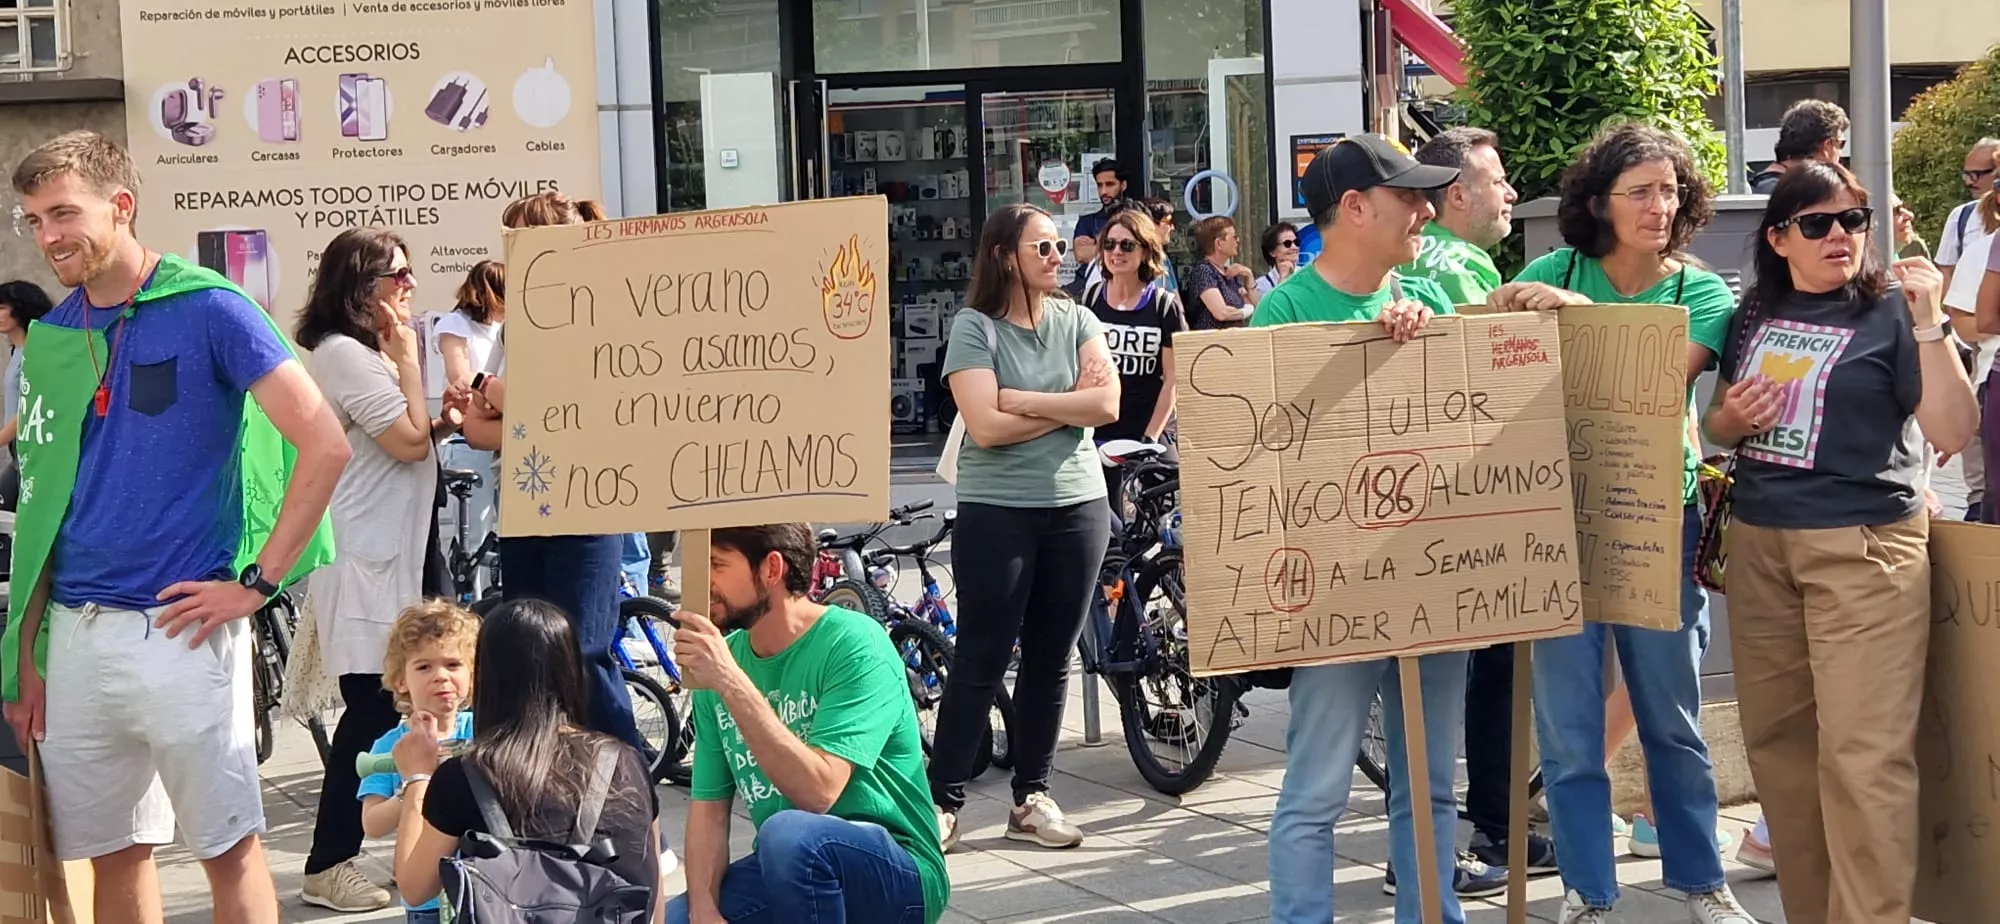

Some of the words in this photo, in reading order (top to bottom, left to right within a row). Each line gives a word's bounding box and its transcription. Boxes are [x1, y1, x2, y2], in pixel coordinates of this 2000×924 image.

[140, 8, 203, 23] Reparación
[205, 7, 220, 19] de
[223, 7, 266, 19] móviles
[269, 8, 276, 19] y
[279, 4, 335, 18] portátiles
[353, 3, 388, 14] Venta
[391, 1, 407, 12] de
[410, 0, 472, 11] accesorios
[475, 1, 481, 12] y
[284, 42, 421, 65] ACCESORIOS
[156, 152, 219, 165] Auriculares
[251, 150, 300, 162] Carcasas
[332, 145, 403, 158] Protectores
[430, 142, 496, 157] Cargadores
[525, 139, 565, 152] Cables
[174, 188, 304, 210] REPARAMOS
[309, 186, 377, 205] TODO
[380, 183, 427, 203] TIPO
[432, 182, 459, 200] DE
[295, 212, 309, 228] Y
[314, 203, 439, 228] PORTÁTILES
[583, 225, 613, 241] IES
[620, 215, 686, 237] HERMANOS
[695, 212, 768, 231] ARGENSOLA
[430, 245, 489, 257] Altavoces
[518, 250, 595, 329] En
[625, 267, 769, 318] verano
[593, 340, 662, 379] nos
[682, 328, 835, 377] asamos,
[1107, 329, 1158, 354] ORE
[1763, 331, 1835, 352] FRENCH
[1561, 323, 1685, 418] ALLAS
[542, 401, 580, 433] en
[615, 390, 781, 428] invierno
[565, 463, 638, 508] nos
[670, 432, 858, 503] CHELAMOS
[1208, 480, 1343, 555] TENGO
[1354, 462, 1421, 520] 186
[1428, 459, 1564, 508] ALUMNOS
[1225, 564, 1244, 606] Y
[1272, 556, 1308, 601] 1H
[1330, 561, 1347, 590] A
[1363, 558, 1396, 581] LA
[1525, 532, 1568, 565] PARA
[1207, 610, 1391, 667] ATENDER
[1411, 603, 1432, 635] A
